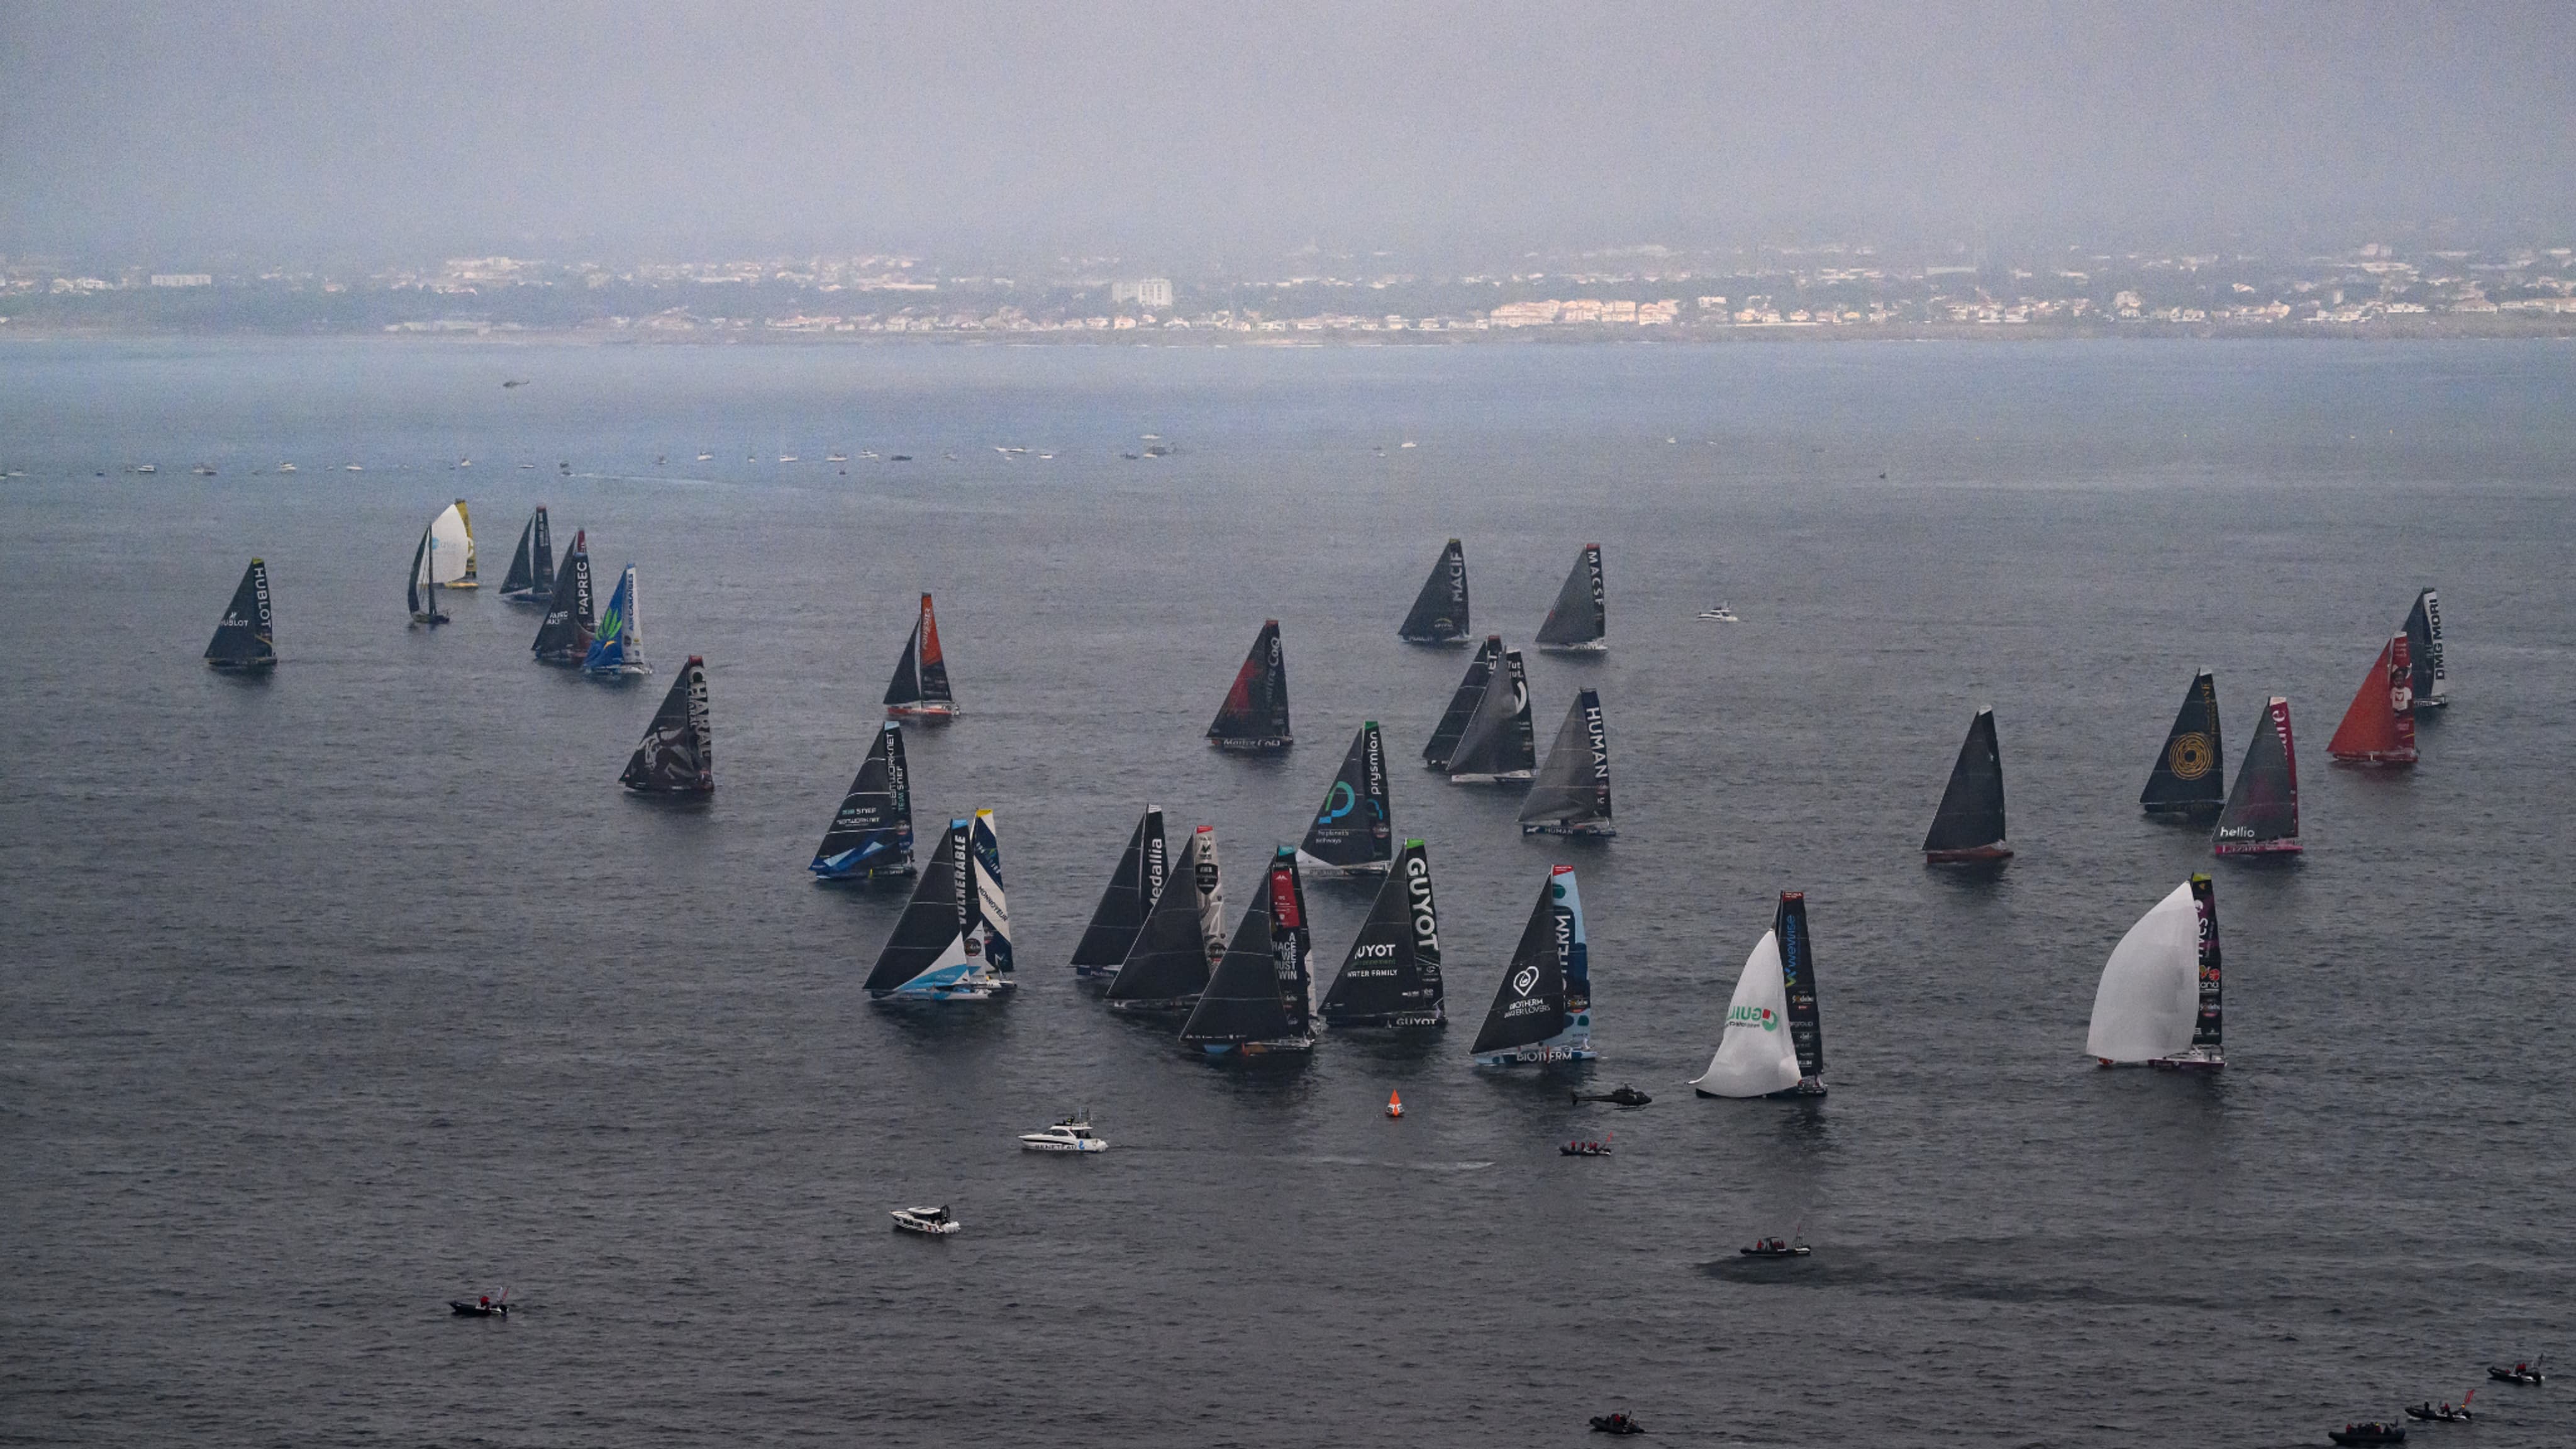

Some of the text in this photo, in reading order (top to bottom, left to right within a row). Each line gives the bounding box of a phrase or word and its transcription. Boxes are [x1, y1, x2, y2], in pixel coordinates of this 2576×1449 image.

[577, 562, 589, 614] PAPREC
[1450, 552, 1463, 602] MACIF
[1587, 552, 1604, 606] MACSF
[254, 567, 271, 628] HUBLOT
[2429, 599, 2443, 640] MORI
[1269, 637, 1280, 667] CoQ
[2434, 643, 2445, 680] DMG
[689, 666, 711, 757] CHARAL
[1586, 707, 1608, 779] HUMAN
[1368, 731, 1381, 795] prysmian
[2220, 826, 2255, 837] hellio
[954, 835, 966, 924] VULNERABLE
[979, 885, 1008, 922] MONNOYEUR
[1407, 858, 1439, 950] GUYOT
[1272, 942, 1296, 951] RACE
[1289, 932, 1296, 941] A
[1354, 945, 1396, 960] UYOT
[1787, 915, 1796, 967] wewise
[1282, 951, 1296, 961] WE
[1371, 969, 1398, 977] FAMILY
[1278, 970, 1297, 980] WIN
[1396, 1017, 1437, 1026] GUYOT
[1509, 997, 1543, 1010] BIOTHERM
[1526, 1004, 1551, 1015] LOVERS
